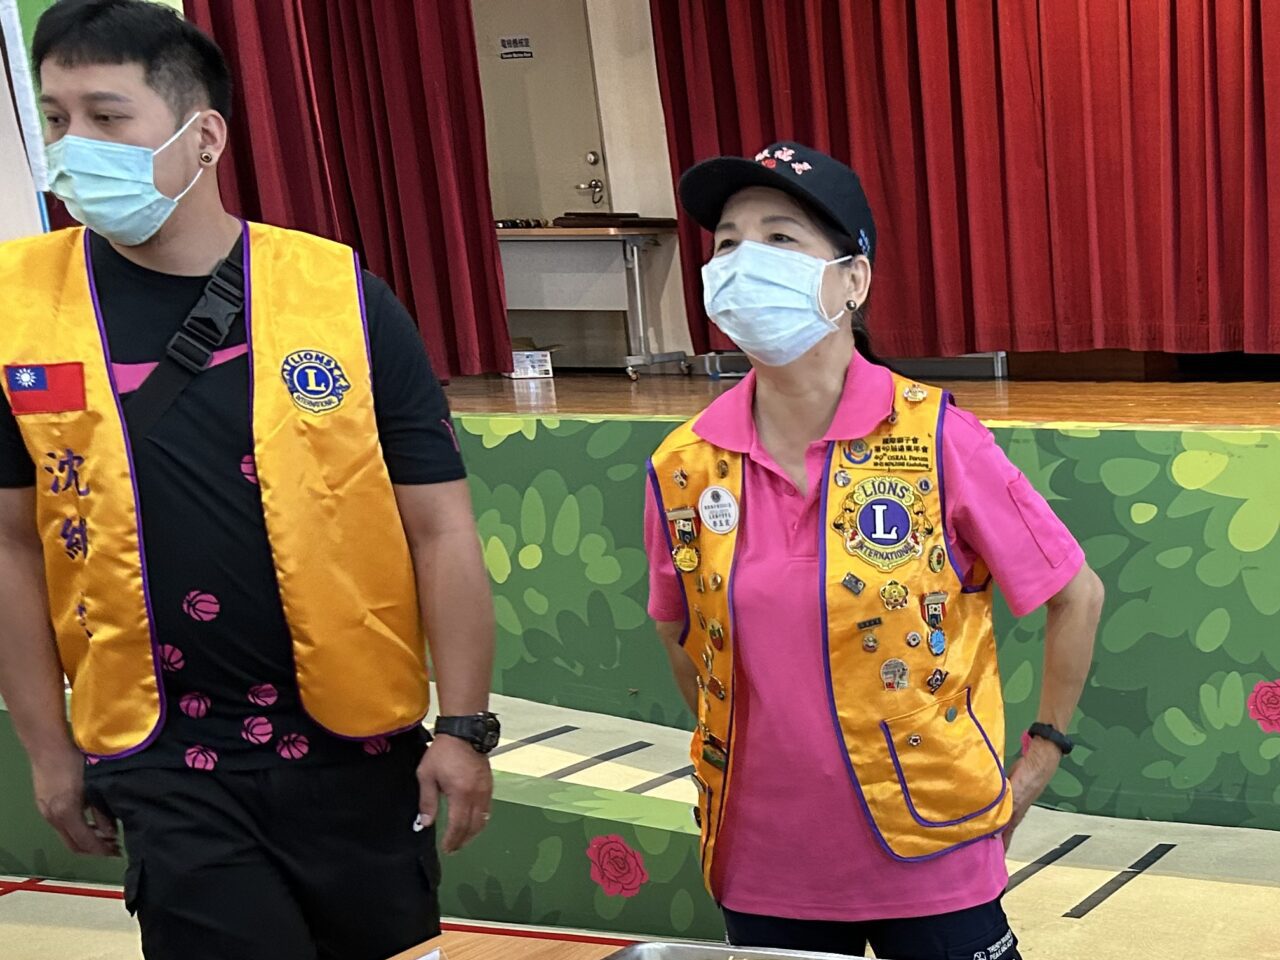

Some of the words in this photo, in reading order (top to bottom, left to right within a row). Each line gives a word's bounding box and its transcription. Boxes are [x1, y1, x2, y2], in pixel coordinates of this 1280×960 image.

[290, 352, 333, 367] LIONS
[304, 368, 327, 391] L
[861, 480, 909, 500] LIONS
[871, 504, 898, 540] L
